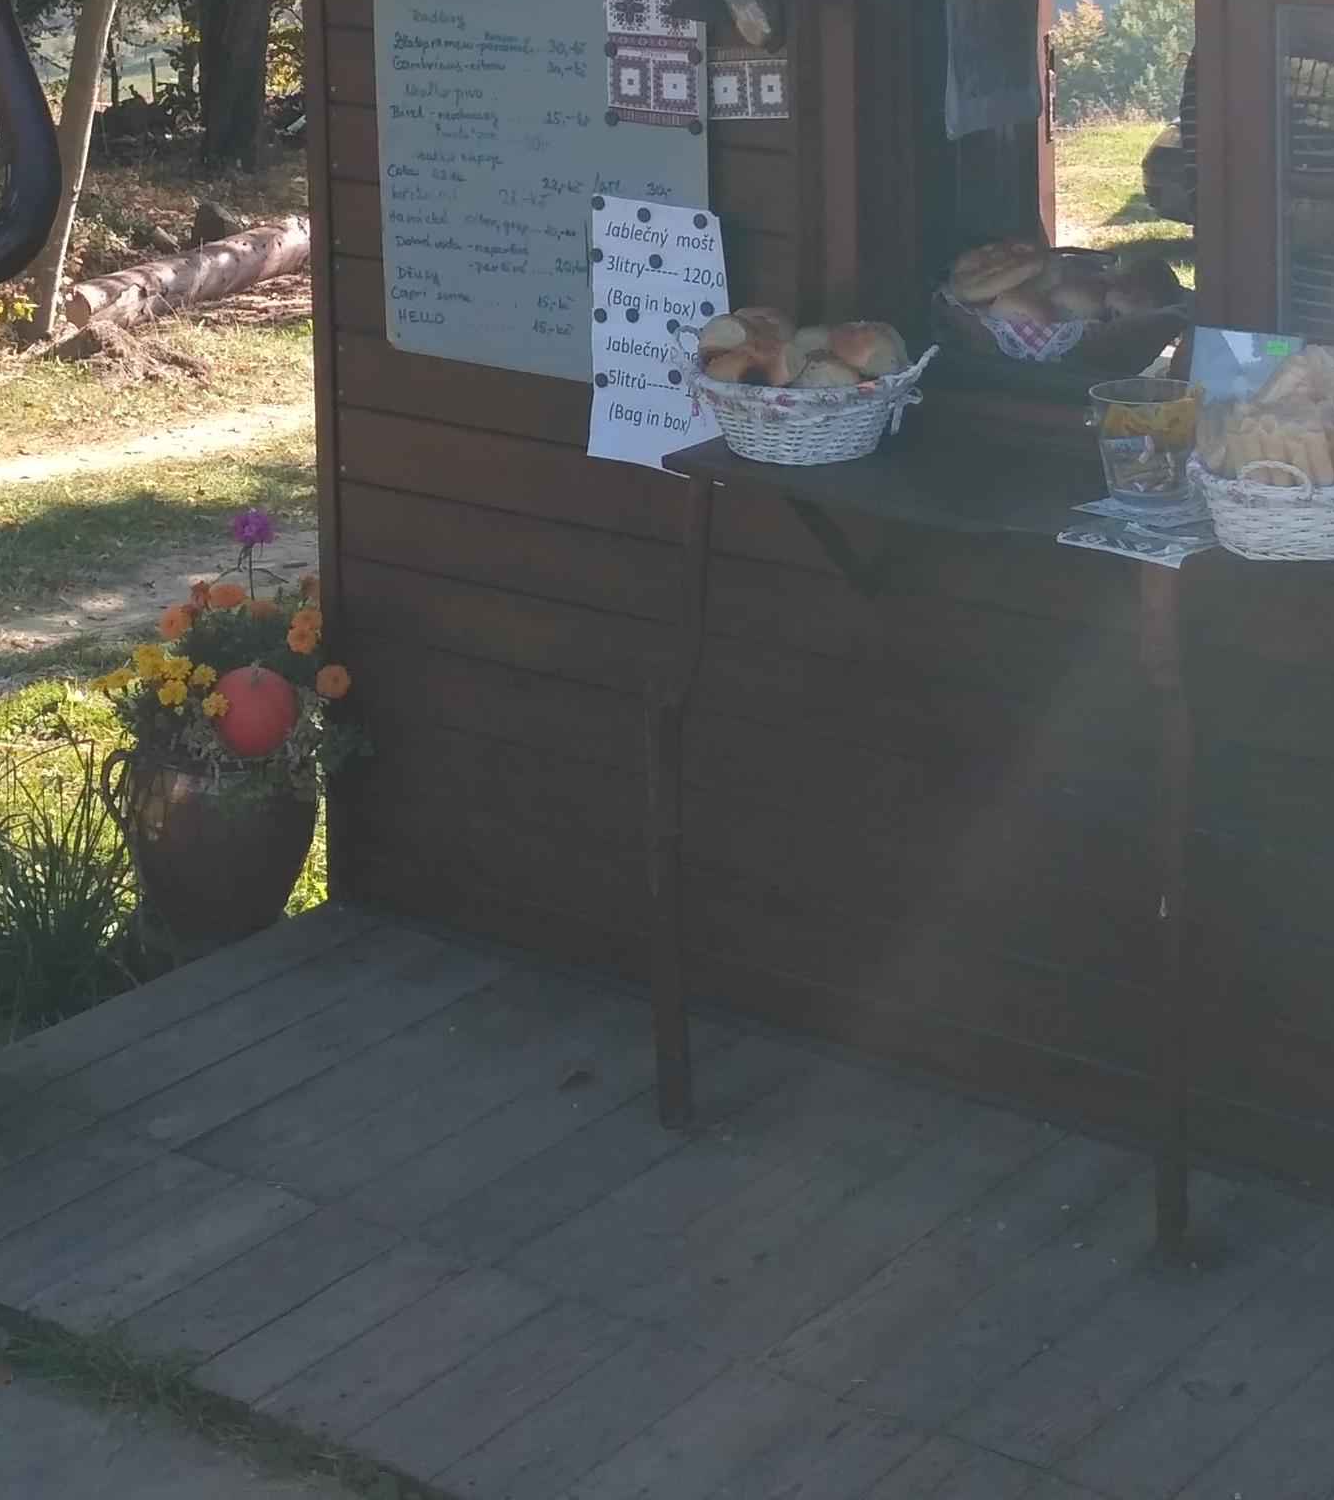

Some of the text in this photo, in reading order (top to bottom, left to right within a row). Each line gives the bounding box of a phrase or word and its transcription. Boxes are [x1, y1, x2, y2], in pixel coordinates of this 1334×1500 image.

[605, 221, 716, 252] Jablečný mošt
[645, 295, 659, 312] in
[663, 297, 697, 320] box)
[605, 335, 669, 362] Jablečný
[608, 401, 643, 427] (Bag
[646, 409, 660, 427] in
